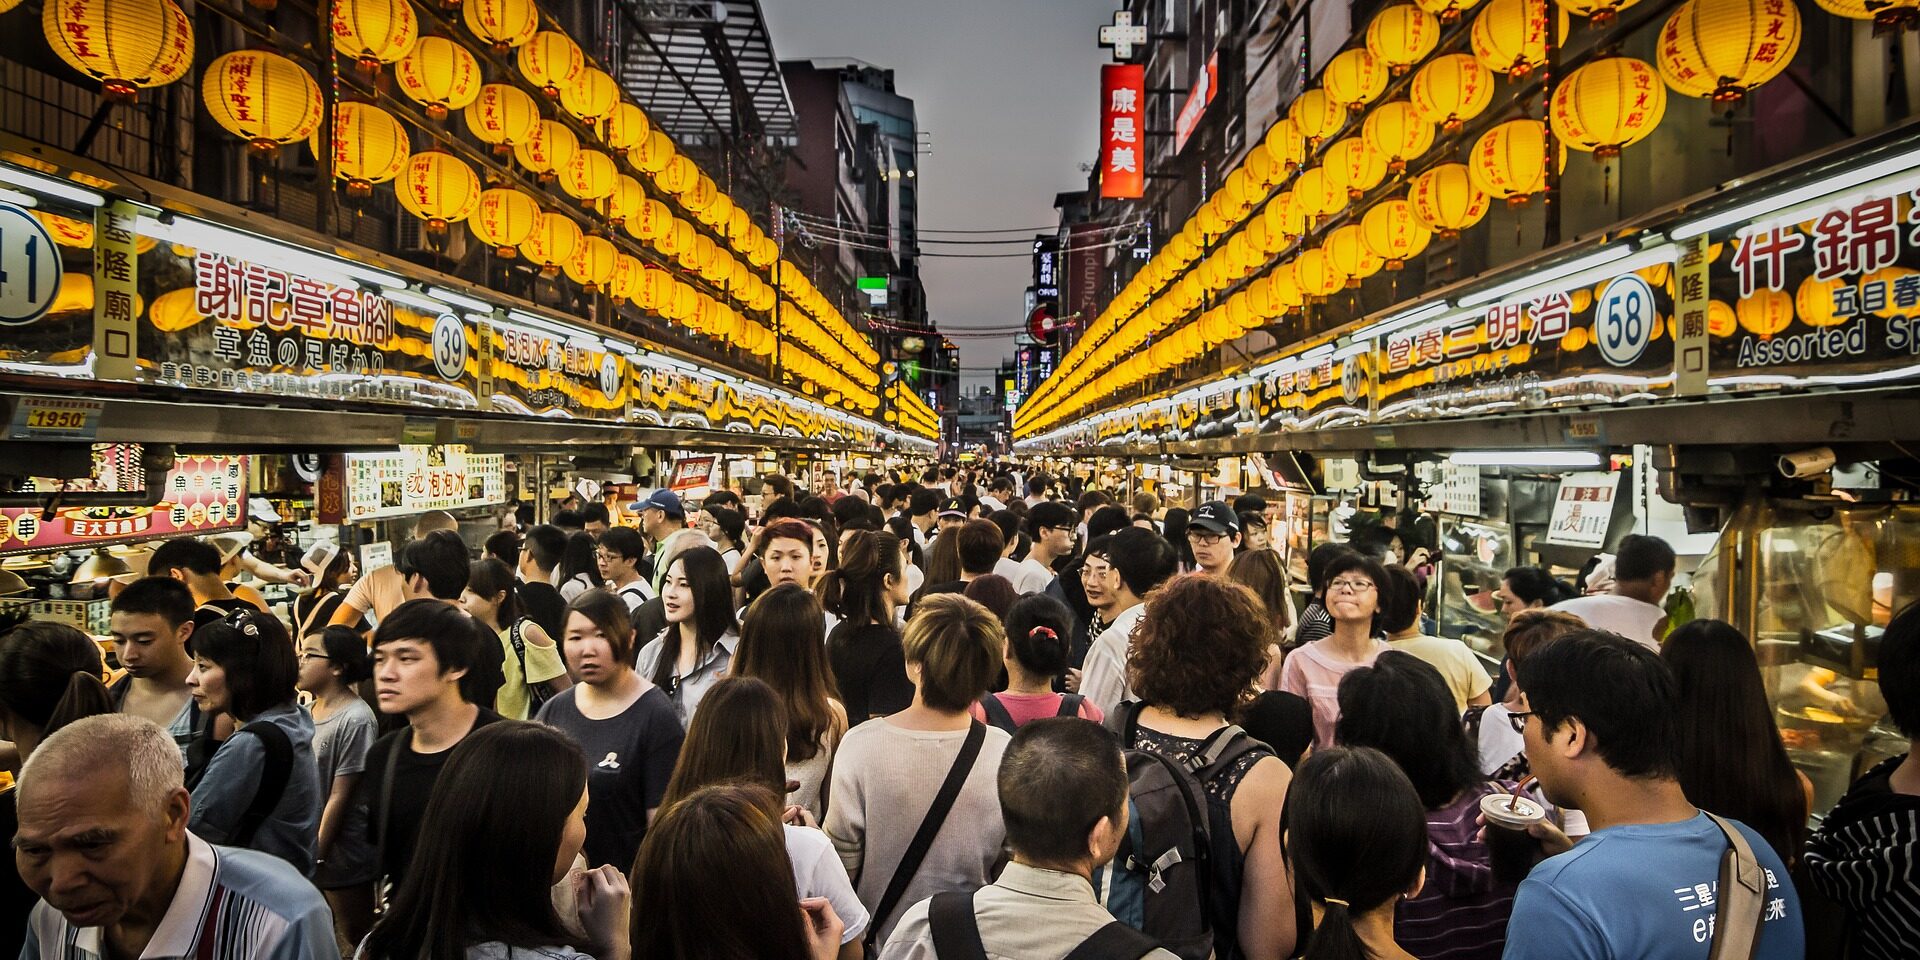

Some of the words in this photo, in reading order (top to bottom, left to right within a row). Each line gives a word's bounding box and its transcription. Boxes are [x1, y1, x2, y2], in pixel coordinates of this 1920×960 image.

[1111, 88, 1136, 174] 康是美
[1733, 188, 1920, 296] 什錦
[103, 202, 131, 359] 基隆廟口
[197, 250, 396, 347] 謝記章魚腳
[1681, 237, 1704, 373] 基隆廟口
[440, 325, 462, 368] 39
[1389, 293, 1570, 372] 營養三明治
[1607, 291, 1641, 350] 58
[1738, 318, 1866, 367] Assorted
[605, 364, 616, 393] 37
[1346, 354, 1362, 391] 56
[35, 411, 82, 428] 1950
[428, 470, 466, 498] 泡泡冰
